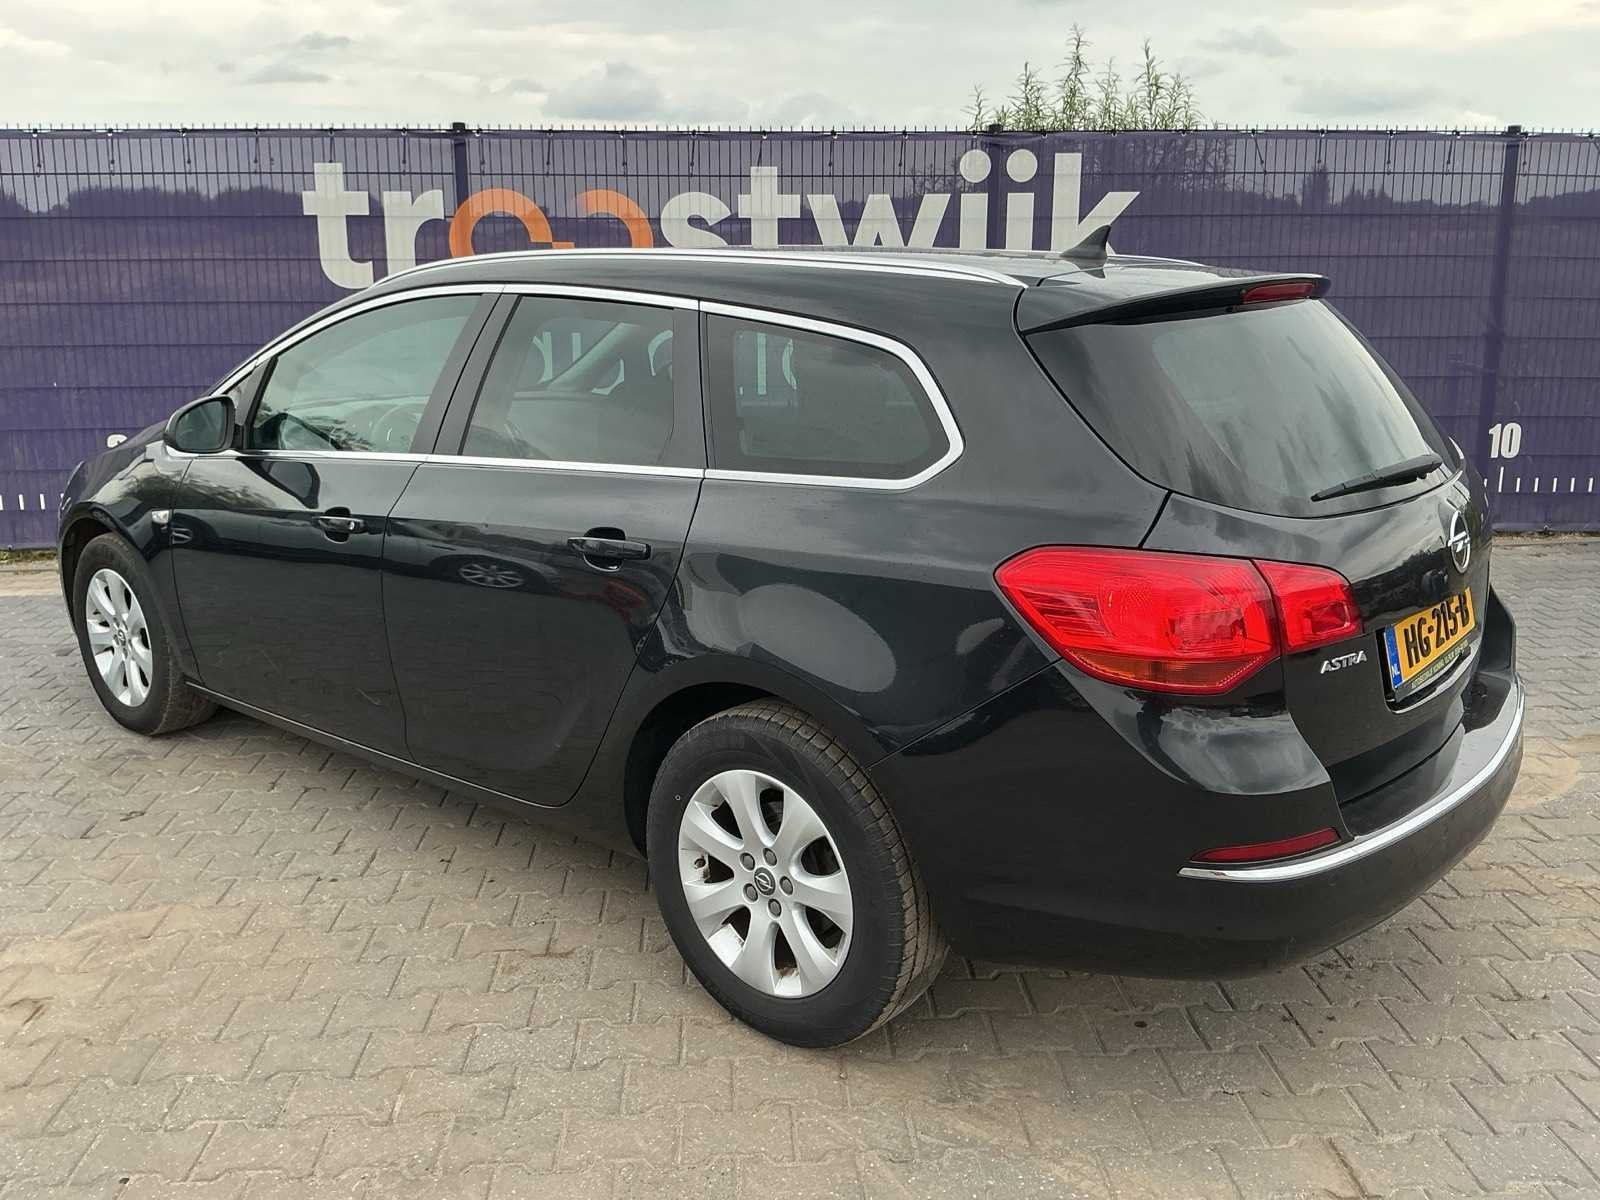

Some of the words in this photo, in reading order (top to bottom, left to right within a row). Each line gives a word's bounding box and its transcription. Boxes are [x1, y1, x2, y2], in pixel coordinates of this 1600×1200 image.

[1489, 422, 1522, 459] 10
[1404, 592, 1470, 668] HG-215-B
[1320, 650, 1367, 675] ASTRA
